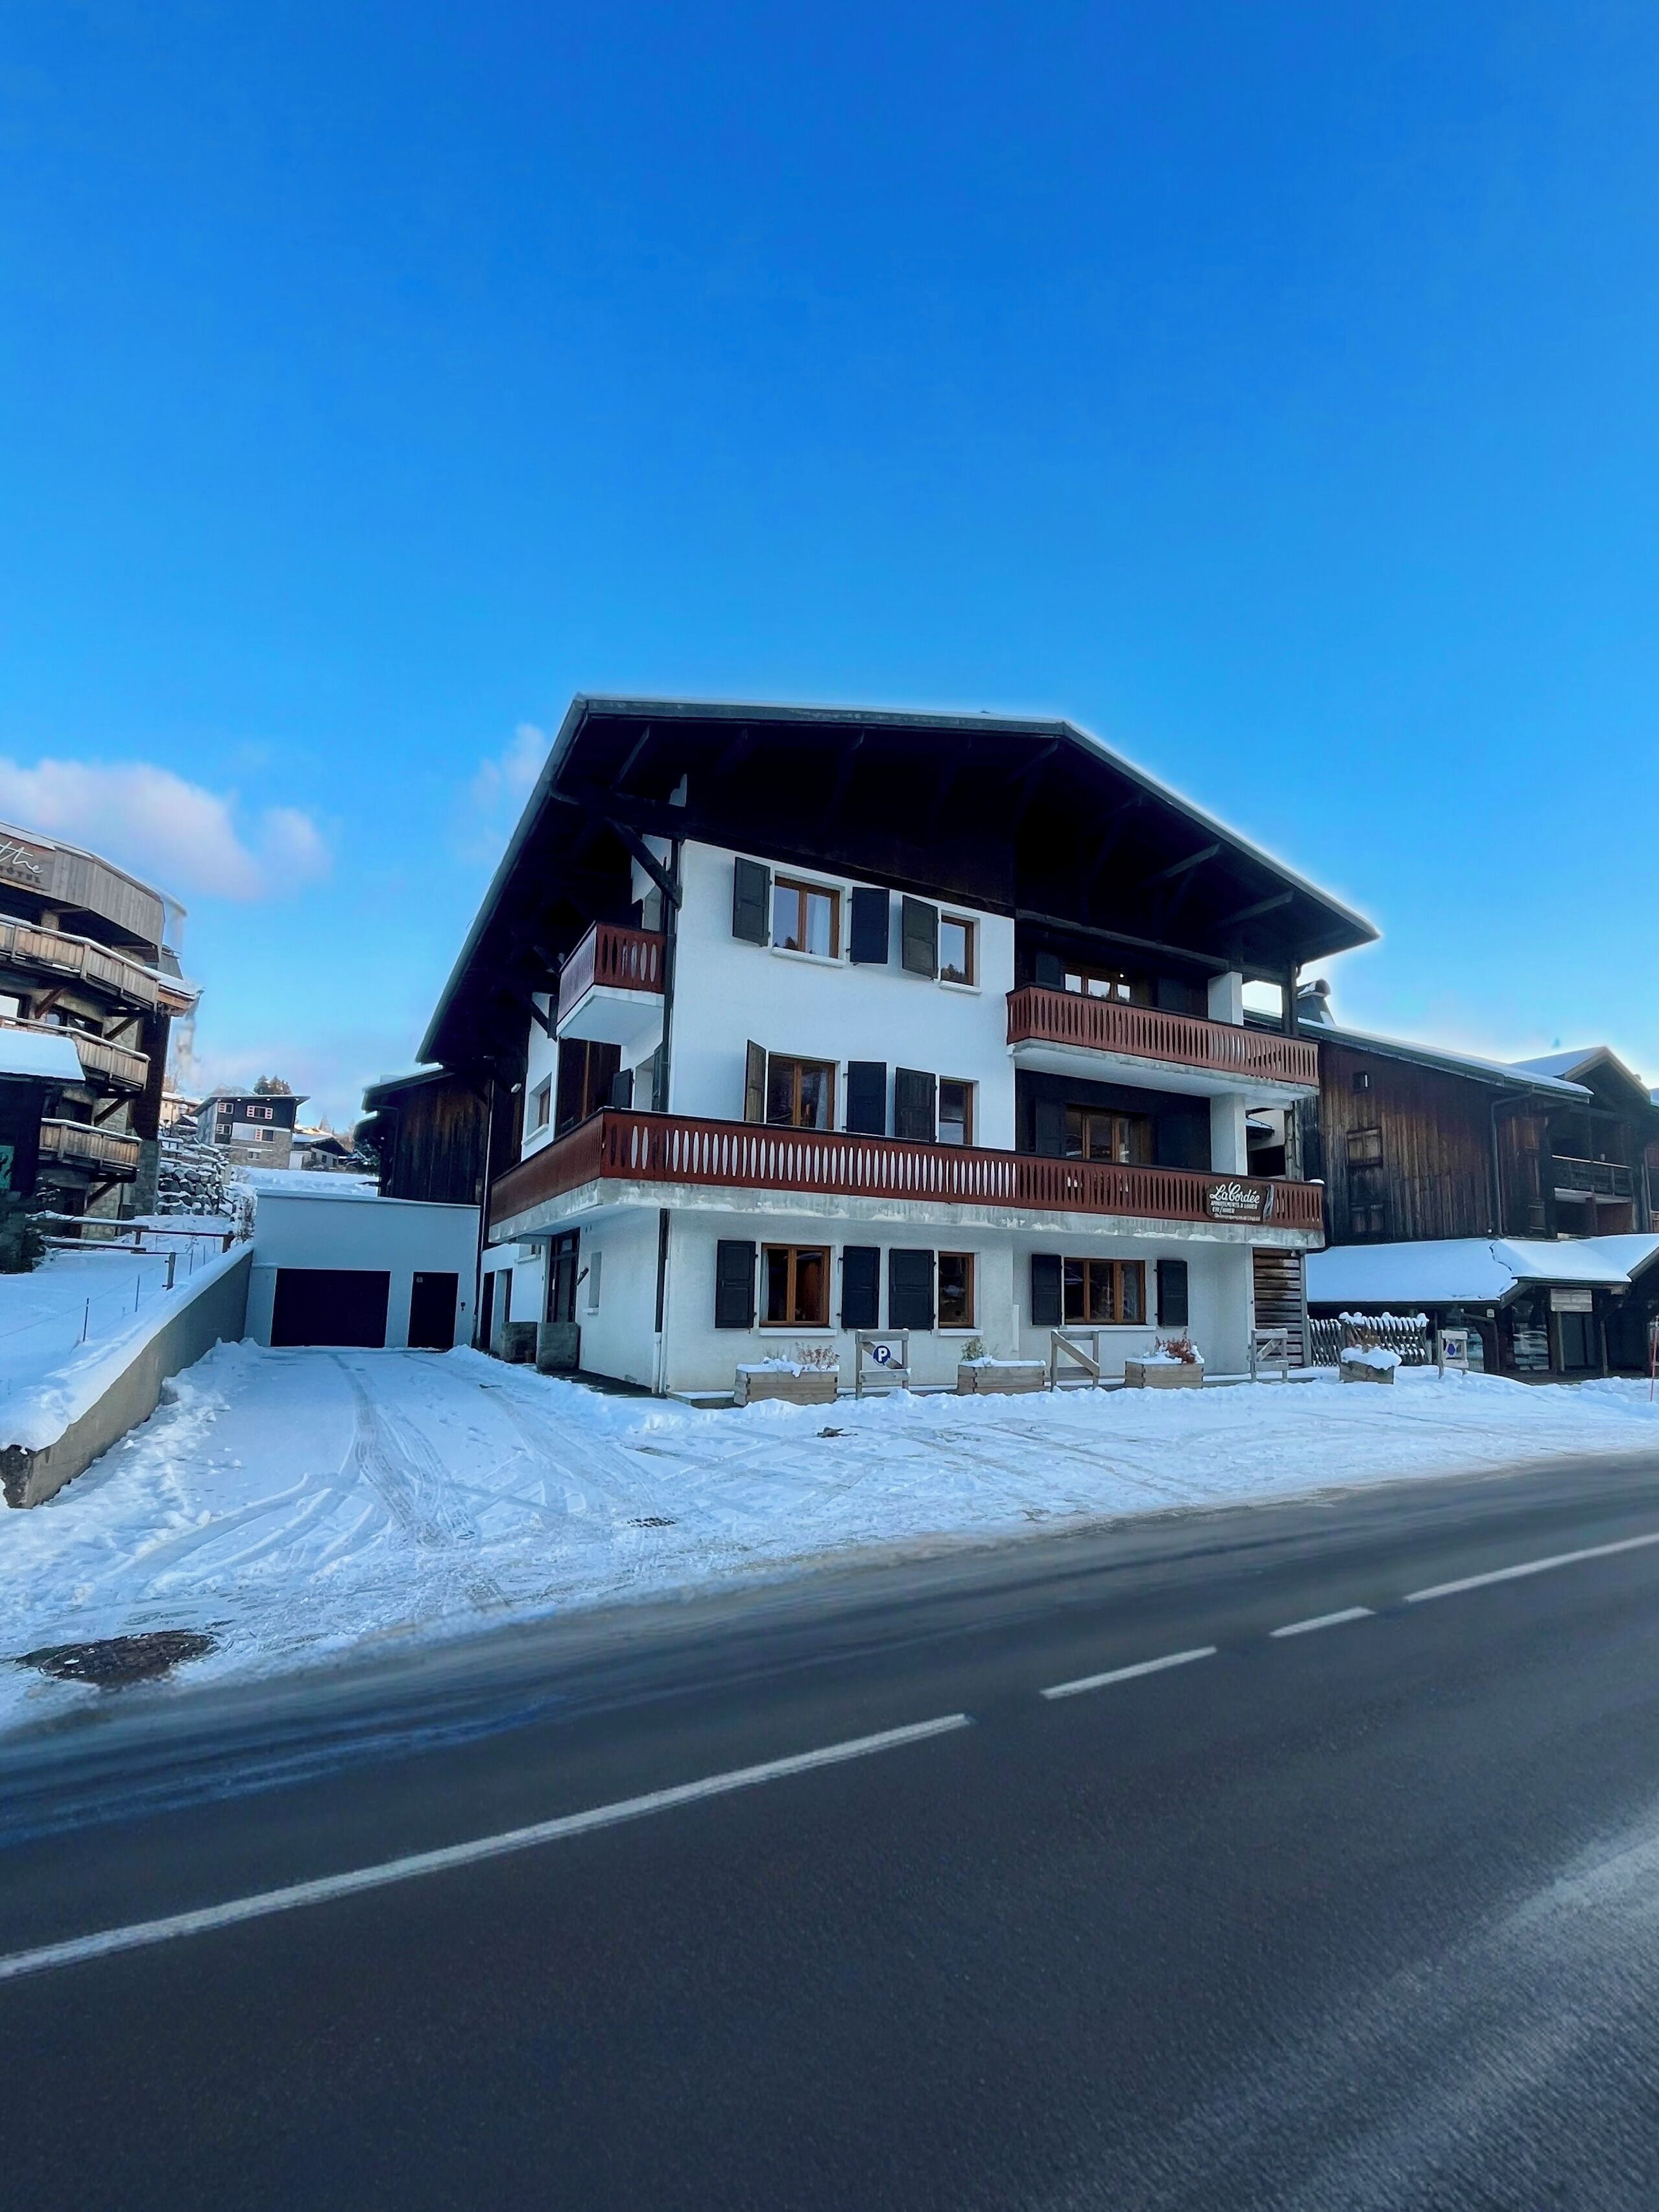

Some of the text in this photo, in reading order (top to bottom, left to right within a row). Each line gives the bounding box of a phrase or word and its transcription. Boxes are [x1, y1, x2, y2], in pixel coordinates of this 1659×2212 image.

[1209, 1182, 1260, 1204] La Cordée
[878, 1348, 888, 1362] P
